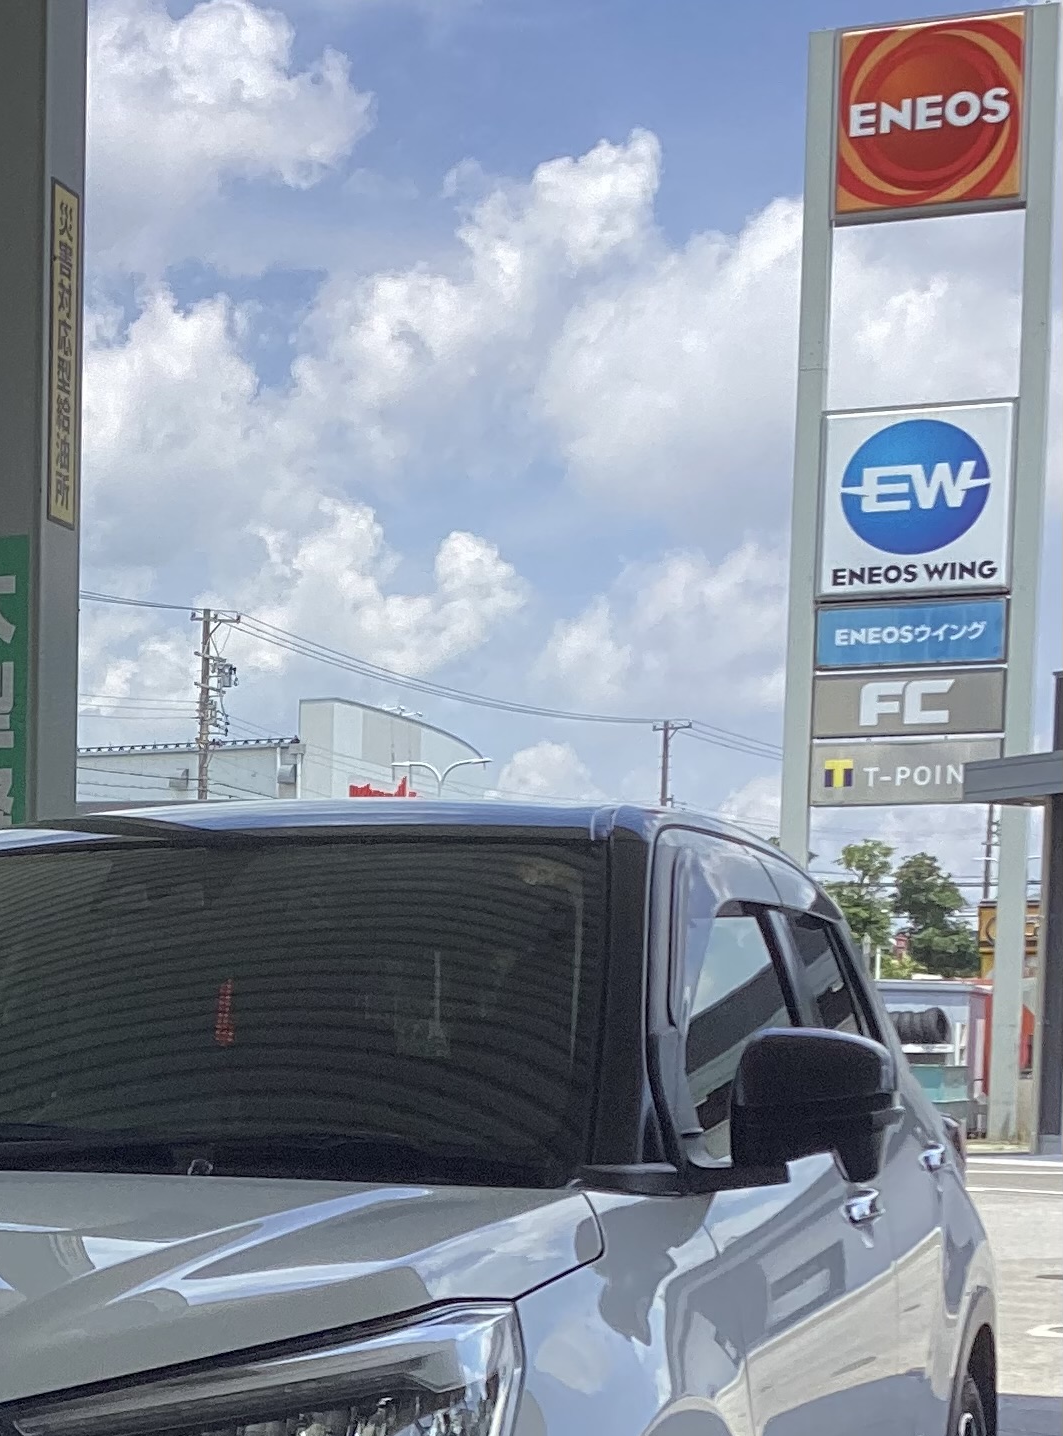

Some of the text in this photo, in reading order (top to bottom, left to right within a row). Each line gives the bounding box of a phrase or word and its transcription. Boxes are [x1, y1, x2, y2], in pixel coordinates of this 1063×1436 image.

[849, 87, 1011, 137] ENEOS
[55, 200, 73, 511] 災害対応型給油所
[841, 460, 990, 513] EW
[831, 560, 999, 587] ENEOS WING
[834, 620, 987, 646] ENEOSウイング
[859, 679, 955, 727] FC
[863, 763, 964, 787] T-POIN
